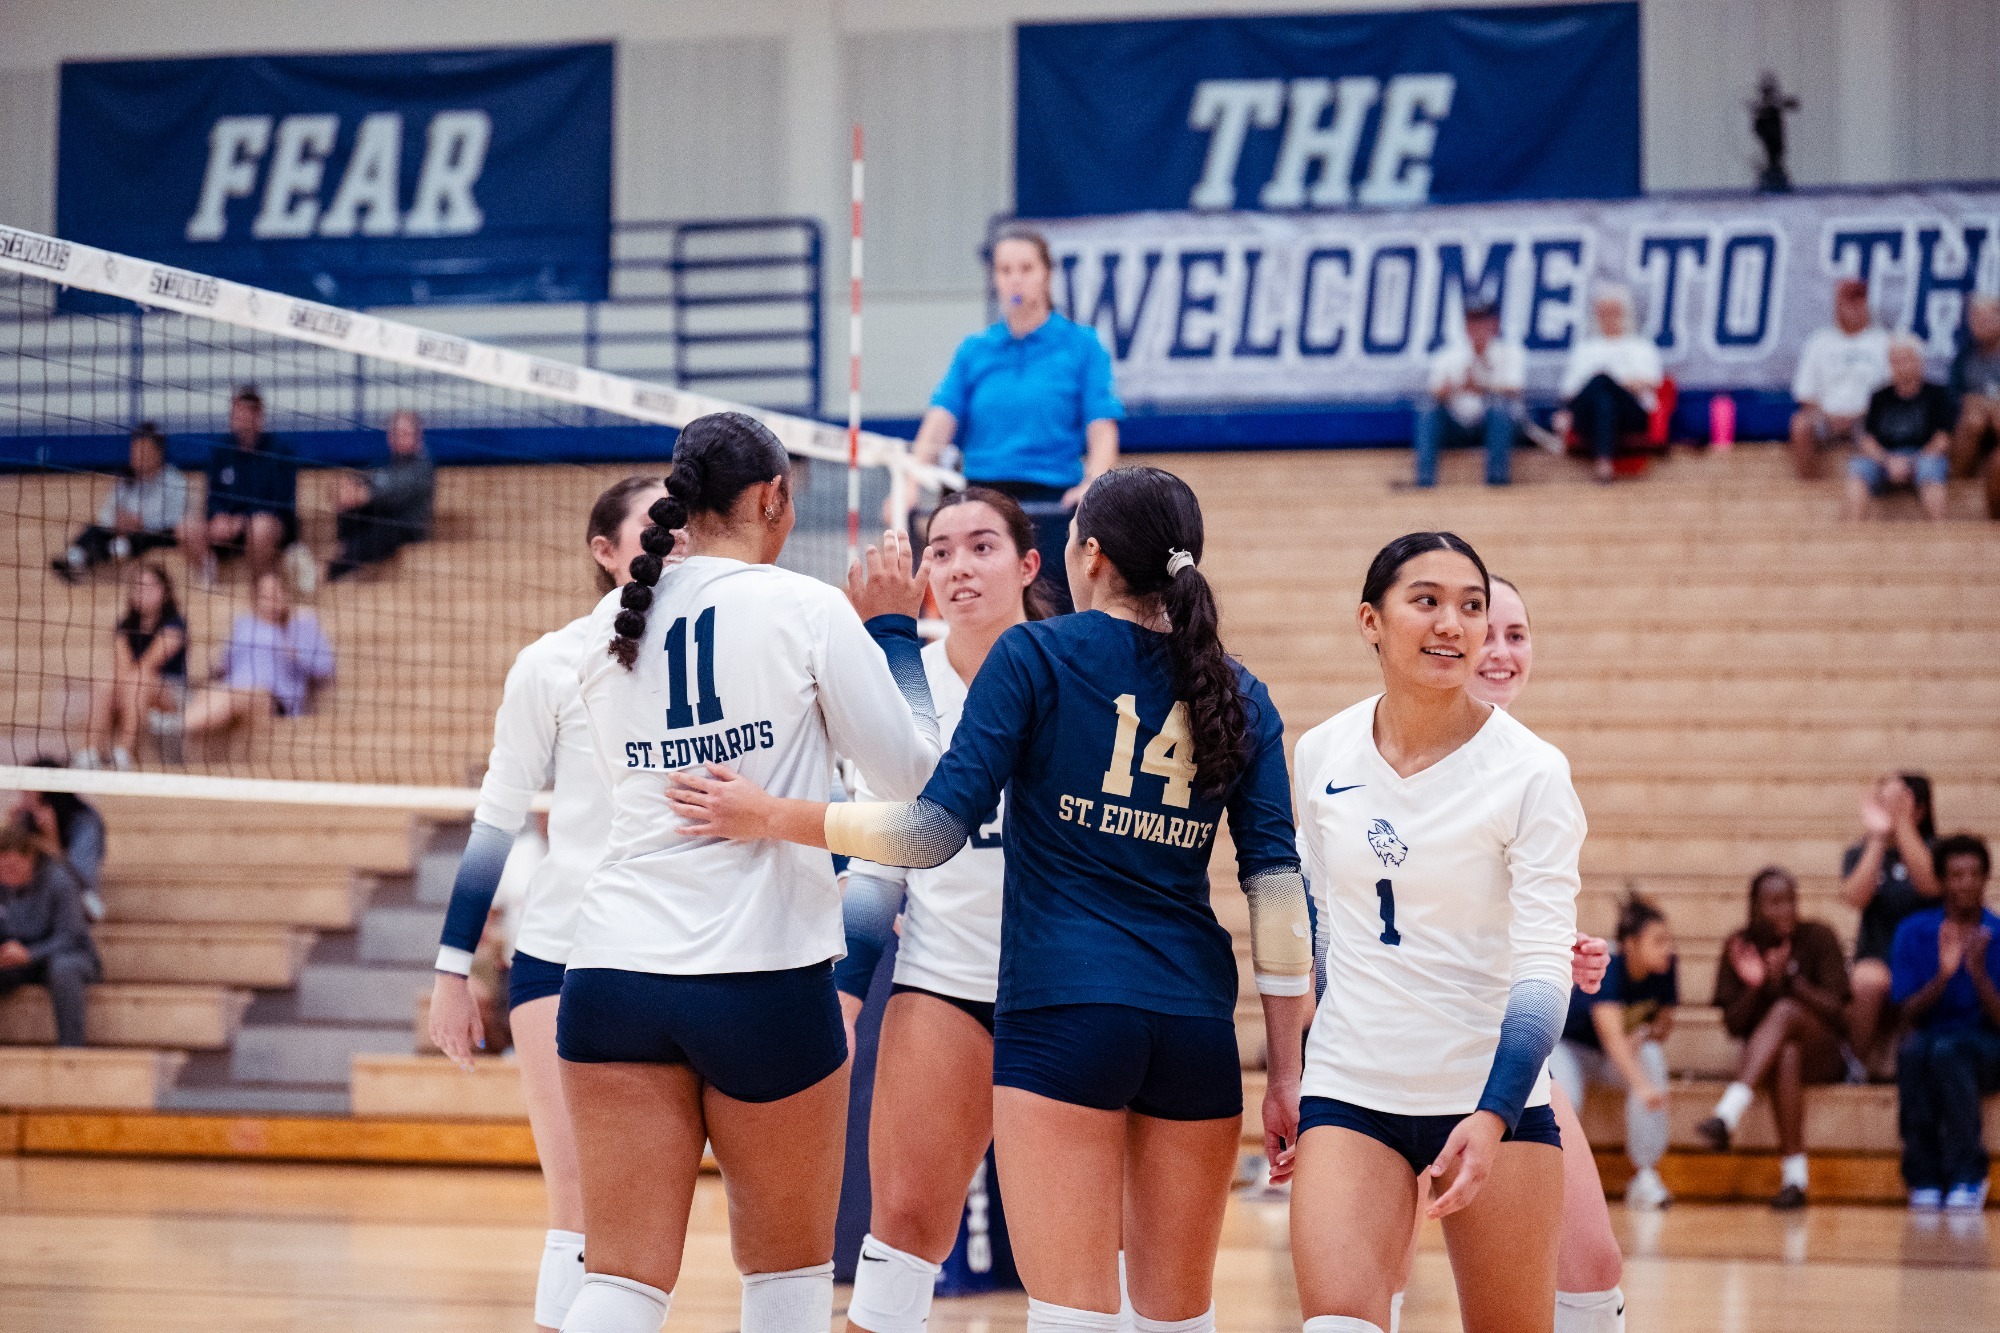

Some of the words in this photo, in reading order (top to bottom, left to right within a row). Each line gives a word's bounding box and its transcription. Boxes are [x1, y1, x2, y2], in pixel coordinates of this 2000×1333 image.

[187, 110, 492, 240] FEAR
[1189, 73, 1455, 209] THE
[1061, 241, 1583, 361] WELCOME
[1640, 234, 1777, 348] TO
[664, 605, 724, 730] 11
[625, 741, 656, 769] ST.
[662, 719, 775, 769] EDWARD'S
[1101, 693, 1198, 809] 14
[1058, 793, 1096, 829] ST.
[1098, 803, 1214, 849] EDWARD'S
[1375, 878, 1402, 947] 1
